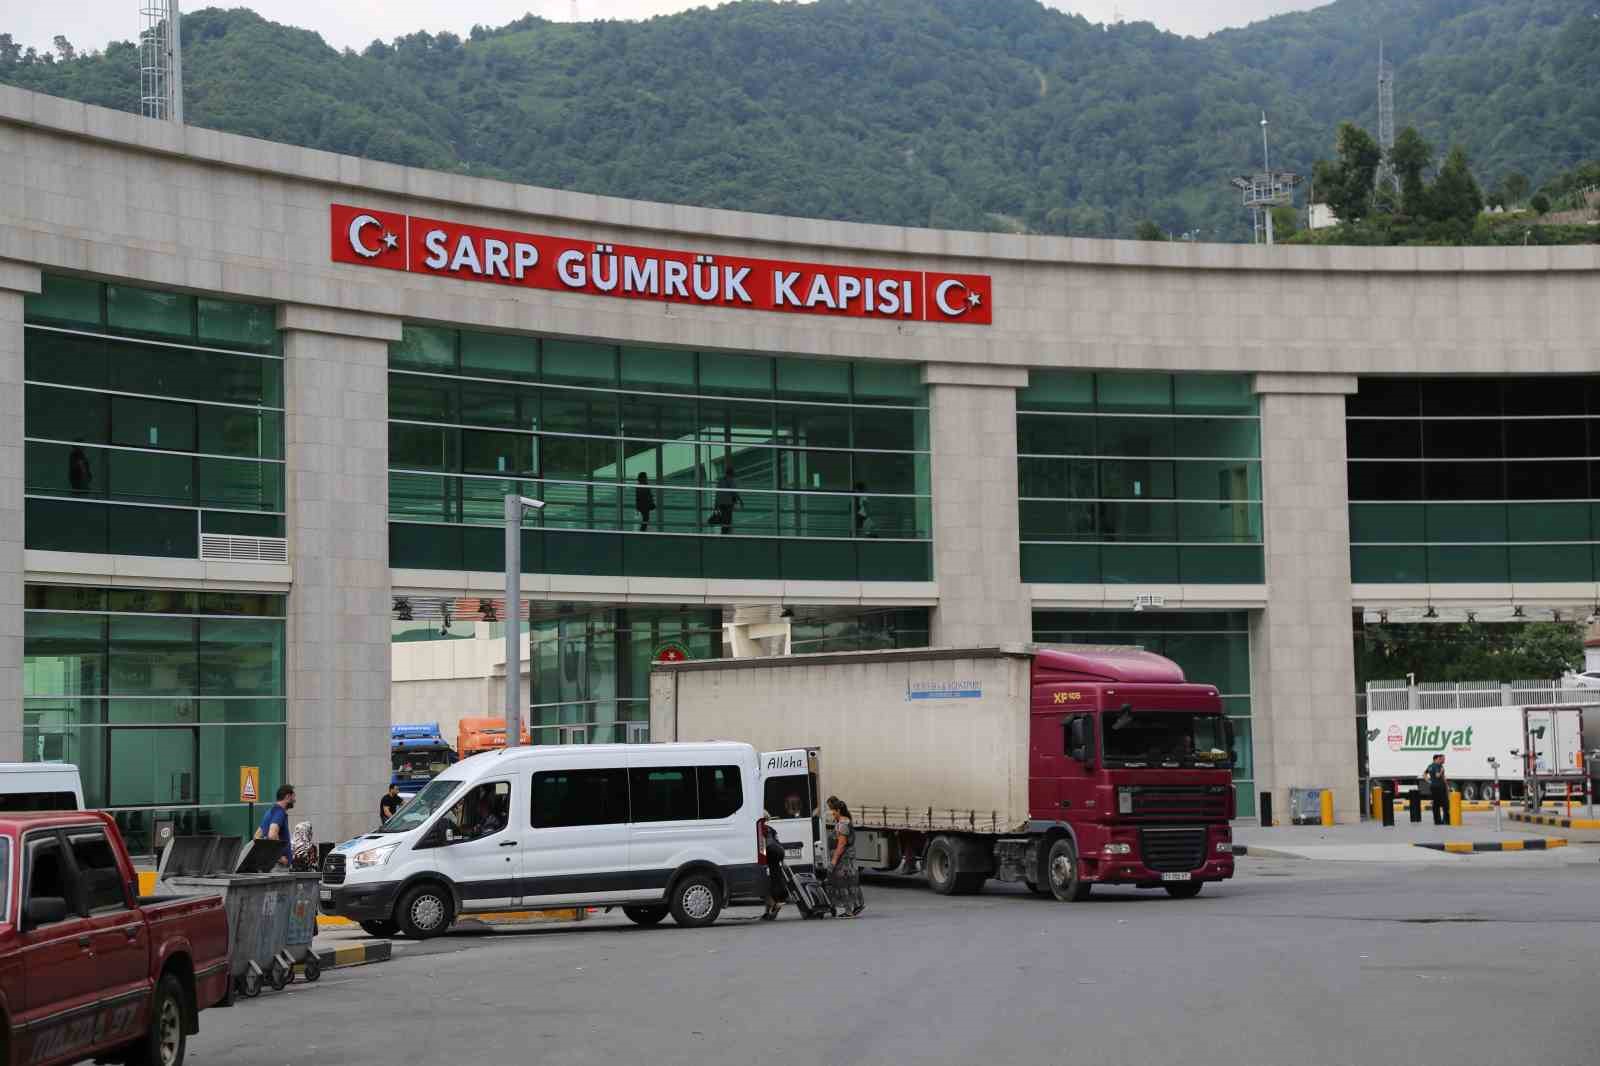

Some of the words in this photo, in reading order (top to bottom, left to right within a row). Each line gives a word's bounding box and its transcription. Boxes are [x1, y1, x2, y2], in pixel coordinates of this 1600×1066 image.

[425, 229, 539, 280] SARP
[557, 244, 752, 303] GÜMRÜK
[774, 270, 913, 315] KAPISI
[1405, 726, 1473, 750] Midyat
[767, 756, 802, 769] Allaha
